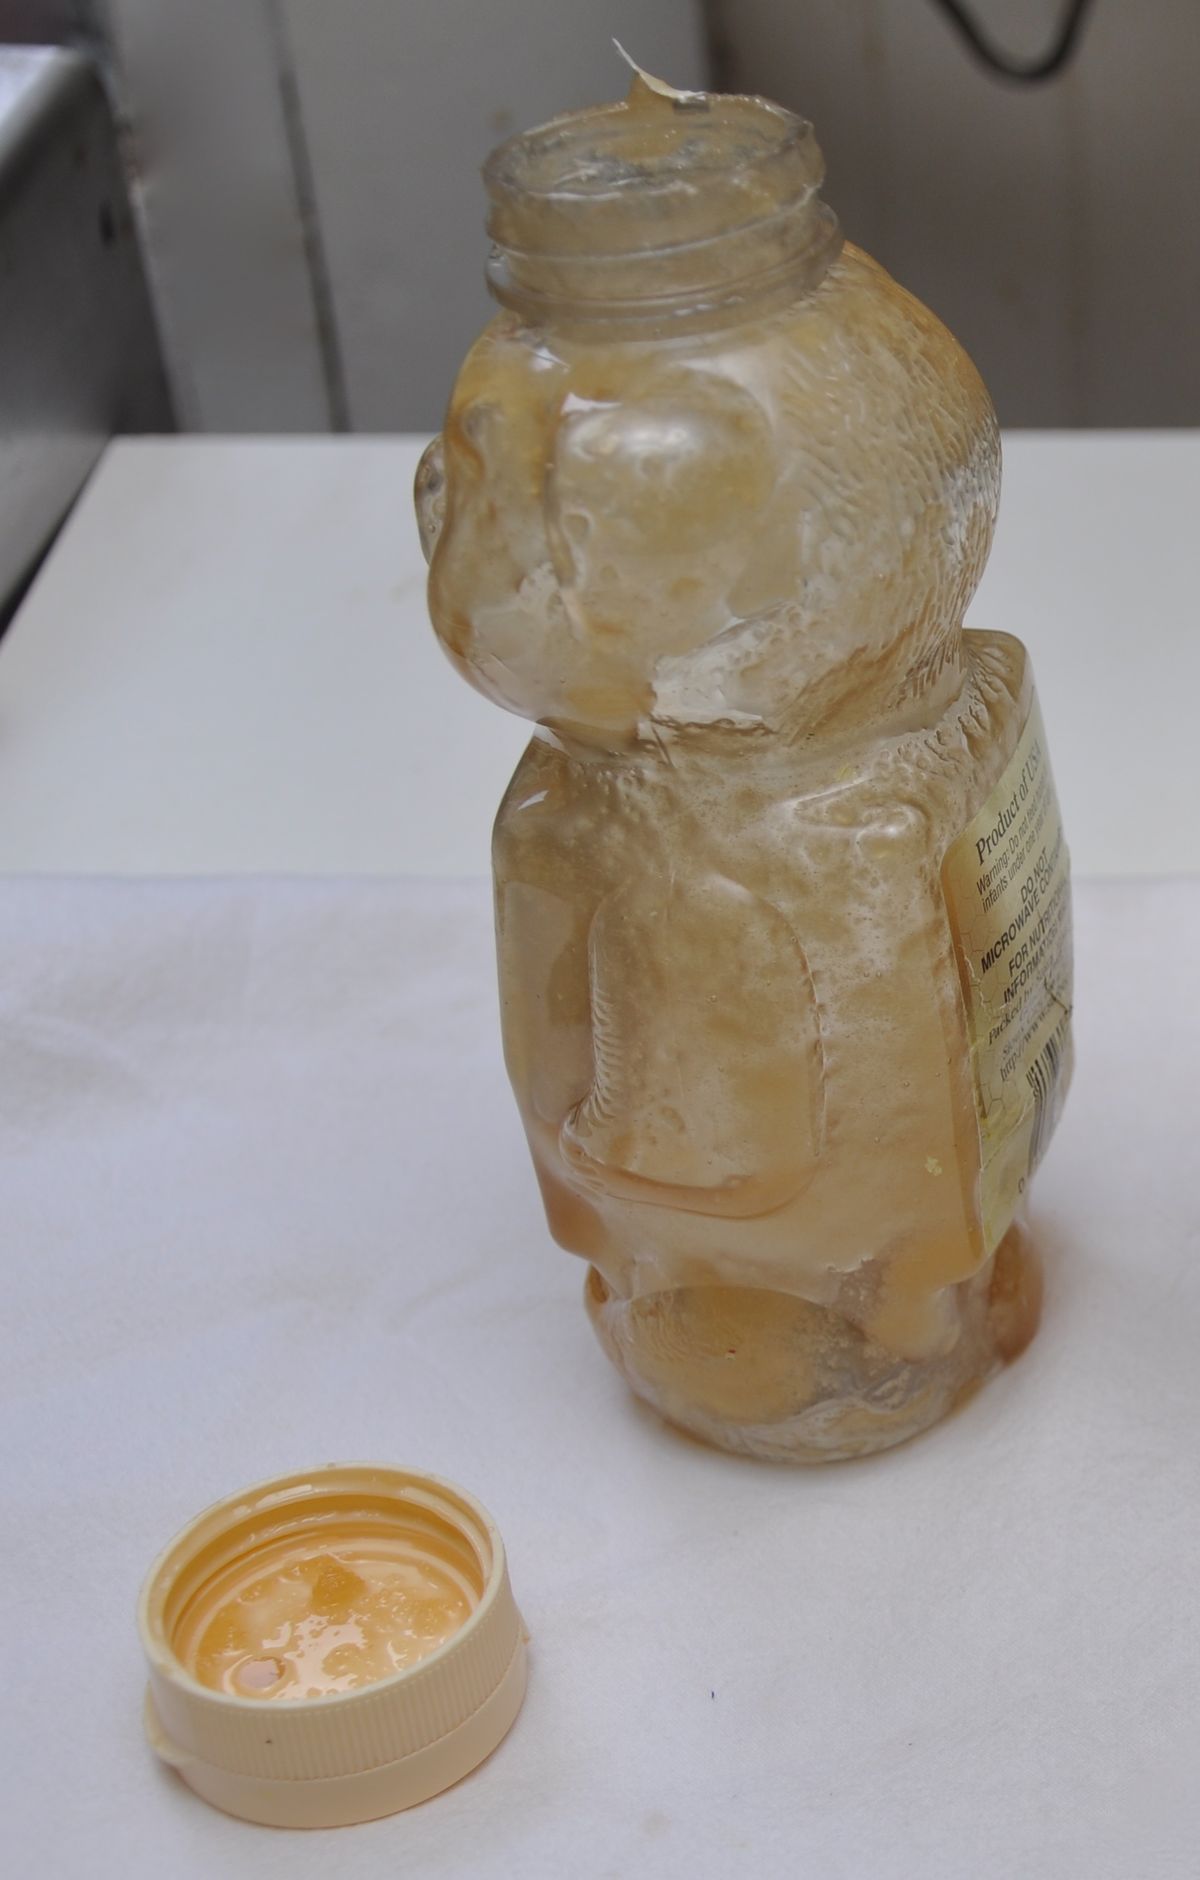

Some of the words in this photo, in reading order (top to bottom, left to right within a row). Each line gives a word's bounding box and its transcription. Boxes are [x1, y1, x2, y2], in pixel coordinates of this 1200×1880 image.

[976, 791, 1020, 866] Product
[1019, 772, 1030, 801] of
[976, 853, 1010, 896] Warning:
[1008, 834, 1021, 855] Do
[981, 874, 1009, 914] infants
[1020, 876, 1035, 905] DO
[1033, 847, 1050, 883] NOT
[980, 888, 1041, 975] MICROWAVE
[1008, 942, 1030, 978] FOR
